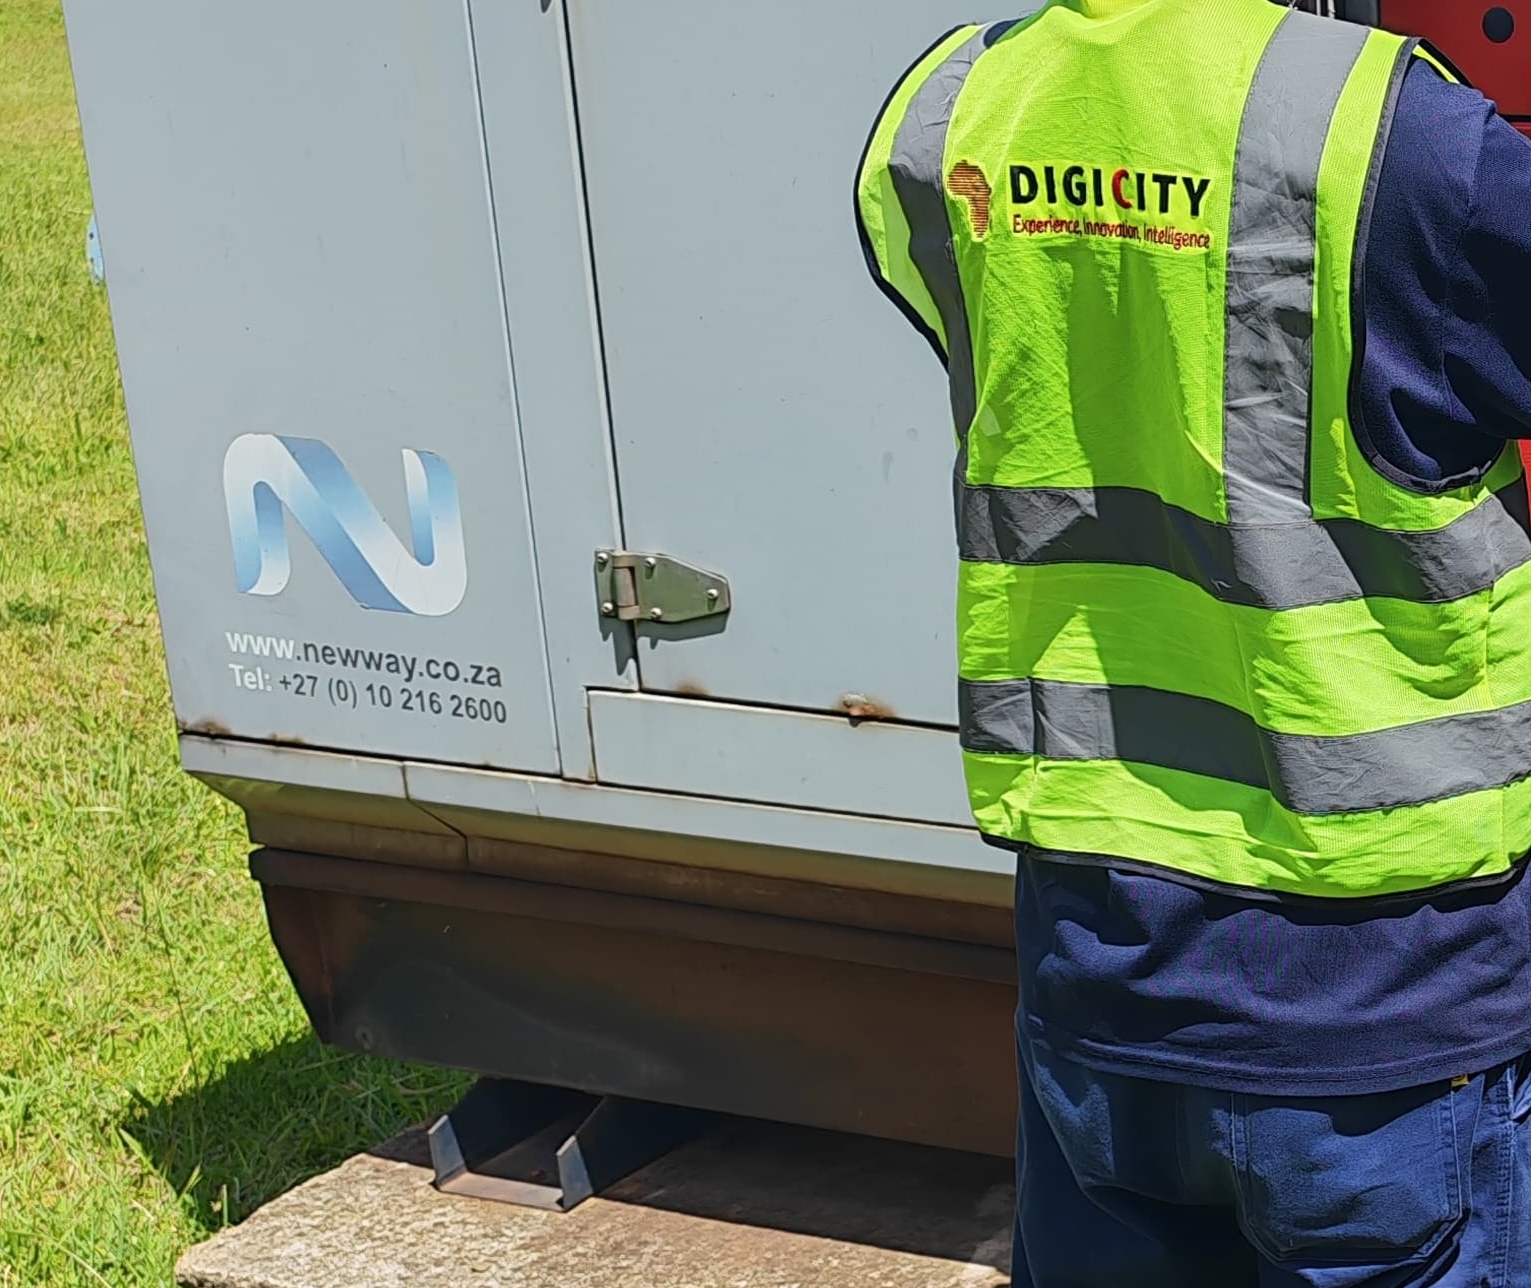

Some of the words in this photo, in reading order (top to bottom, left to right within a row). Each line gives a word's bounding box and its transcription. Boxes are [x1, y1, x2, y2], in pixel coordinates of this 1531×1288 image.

[1009, 165, 1211, 218] DIGICITY
[1144, 223, 1211, 250] Intelligence
[225, 631, 503, 688] www.newway.co.za
[229, 663, 273, 692] Tel:
[279, 673, 318, 697] +27
[328, 677, 358, 709] (0)
[366, 684, 392, 708] 10
[400, 688, 443, 714] 216
[450, 695, 508, 724] 2600
